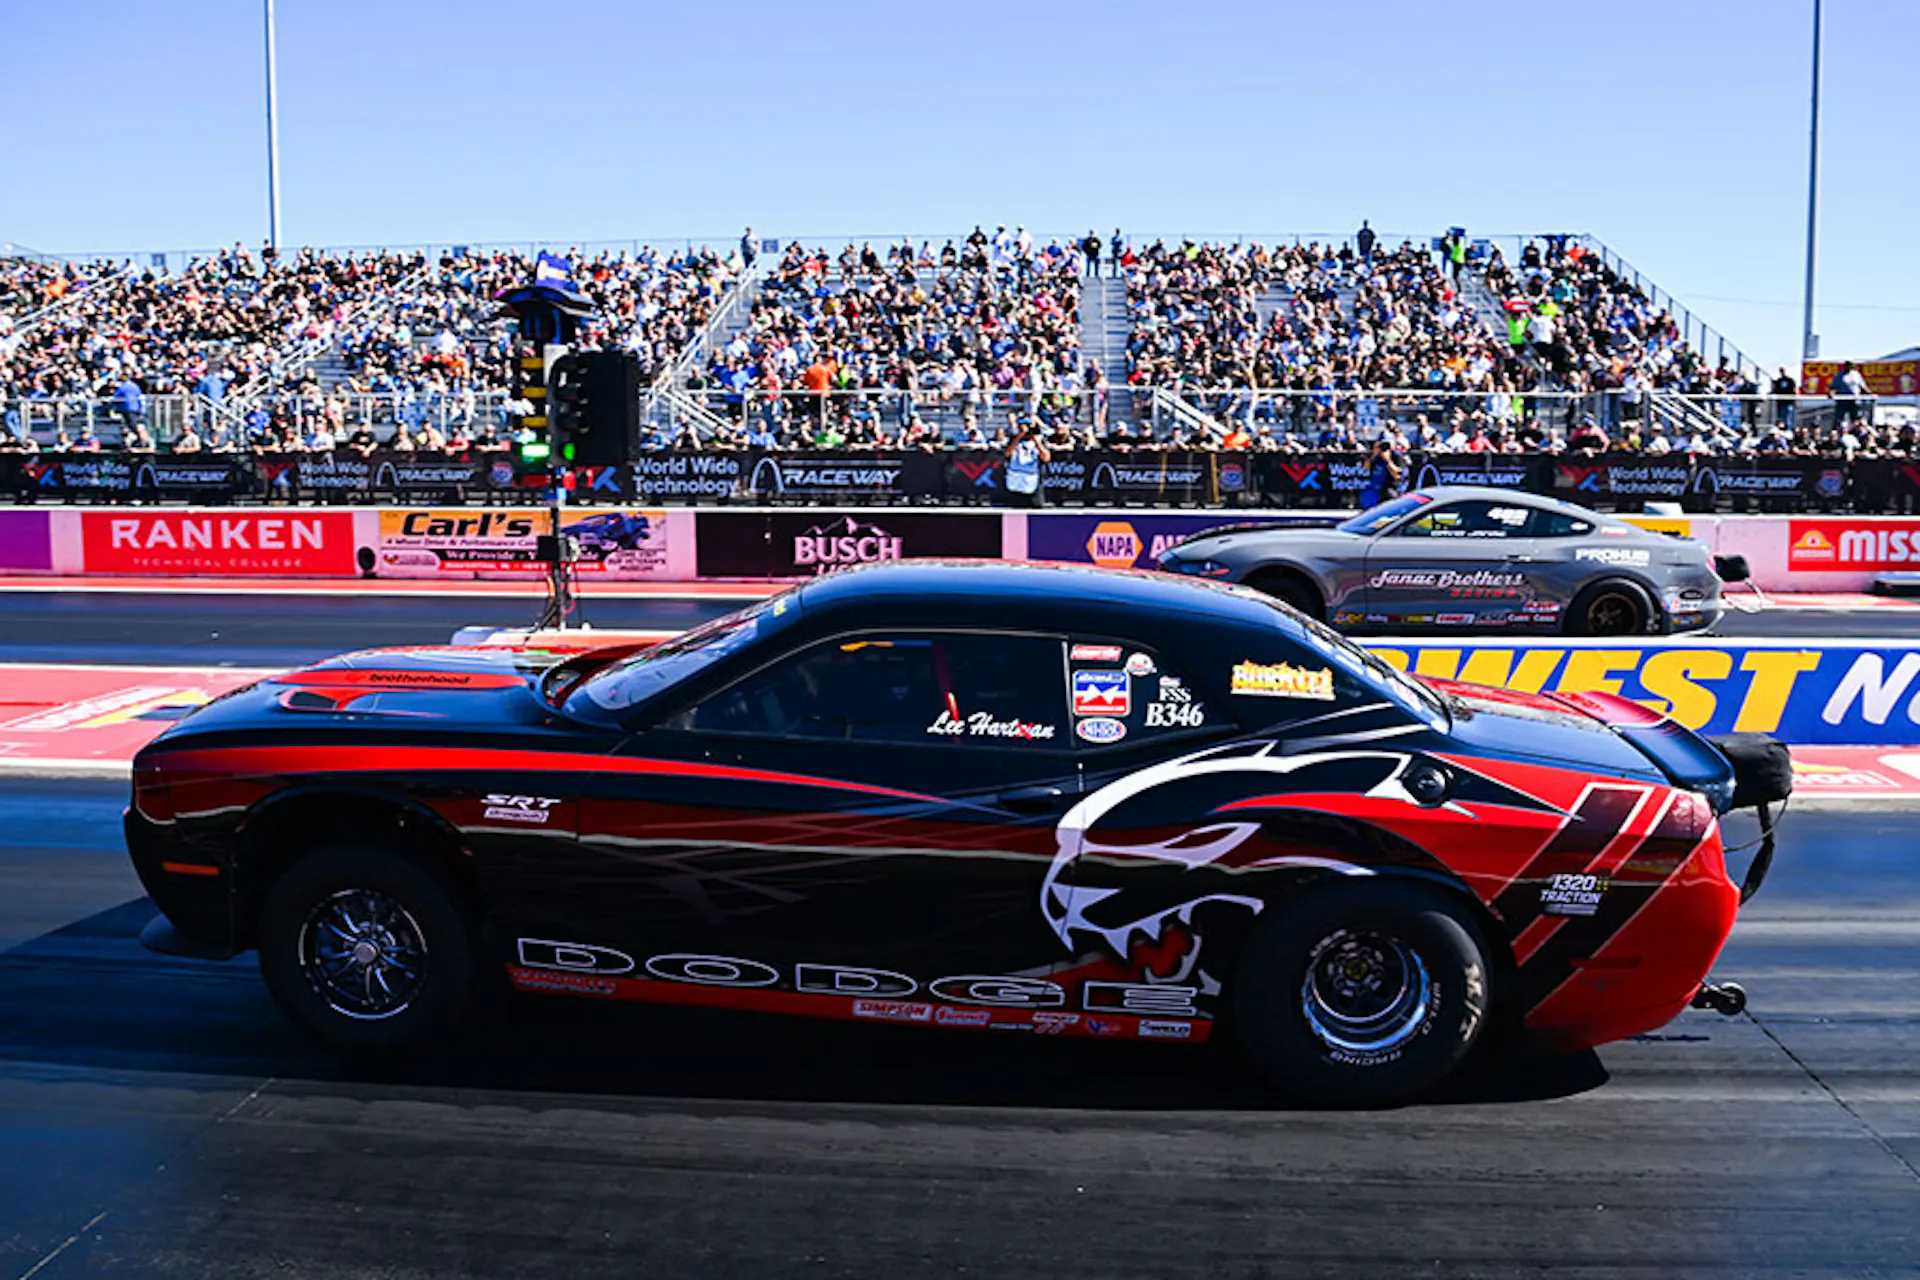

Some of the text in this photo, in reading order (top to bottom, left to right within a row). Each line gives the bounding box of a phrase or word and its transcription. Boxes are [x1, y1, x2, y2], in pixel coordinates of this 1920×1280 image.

[298, 462, 369, 474] World Wide
[632, 457, 738, 474] World Wide
[1050, 462, 1085, 474] Wide
[1608, 467, 1685, 479] World Wide
[157, 471, 229, 481] RACEWAY
[300, 475, 370, 488] Technology
[398, 470, 474, 481] RACEWAY
[783, 470, 900, 485] RACEWAY
[1118, 471, 1201, 482] RACEWAY
[1441, 473, 1525, 484] RACEWAY
[1719, 477, 1801, 488] RACEWAY
[633, 476, 740, 495] Technology
[1609, 481, 1688, 495] Technology
[402, 512, 532, 537] Carl's
[111, 520, 322, 549] RANKEN
[794, 537, 903, 564] BUSCH
[1097, 536, 1133, 556] NAPA
[463, 550, 510, 559] Provide
[229, 558, 303, 567] COLLEGE
[1437, 570, 1525, 588] Brothers
[1143, 702, 1204, 727] B346
[927, 710, 965, 735] Lee
[480, 793, 562, 811] SRT
[1552, 874, 1597, 891] 1320
[1540, 889, 1602, 904] TRACTION
[517, 937, 1197, 1016] DODGE
